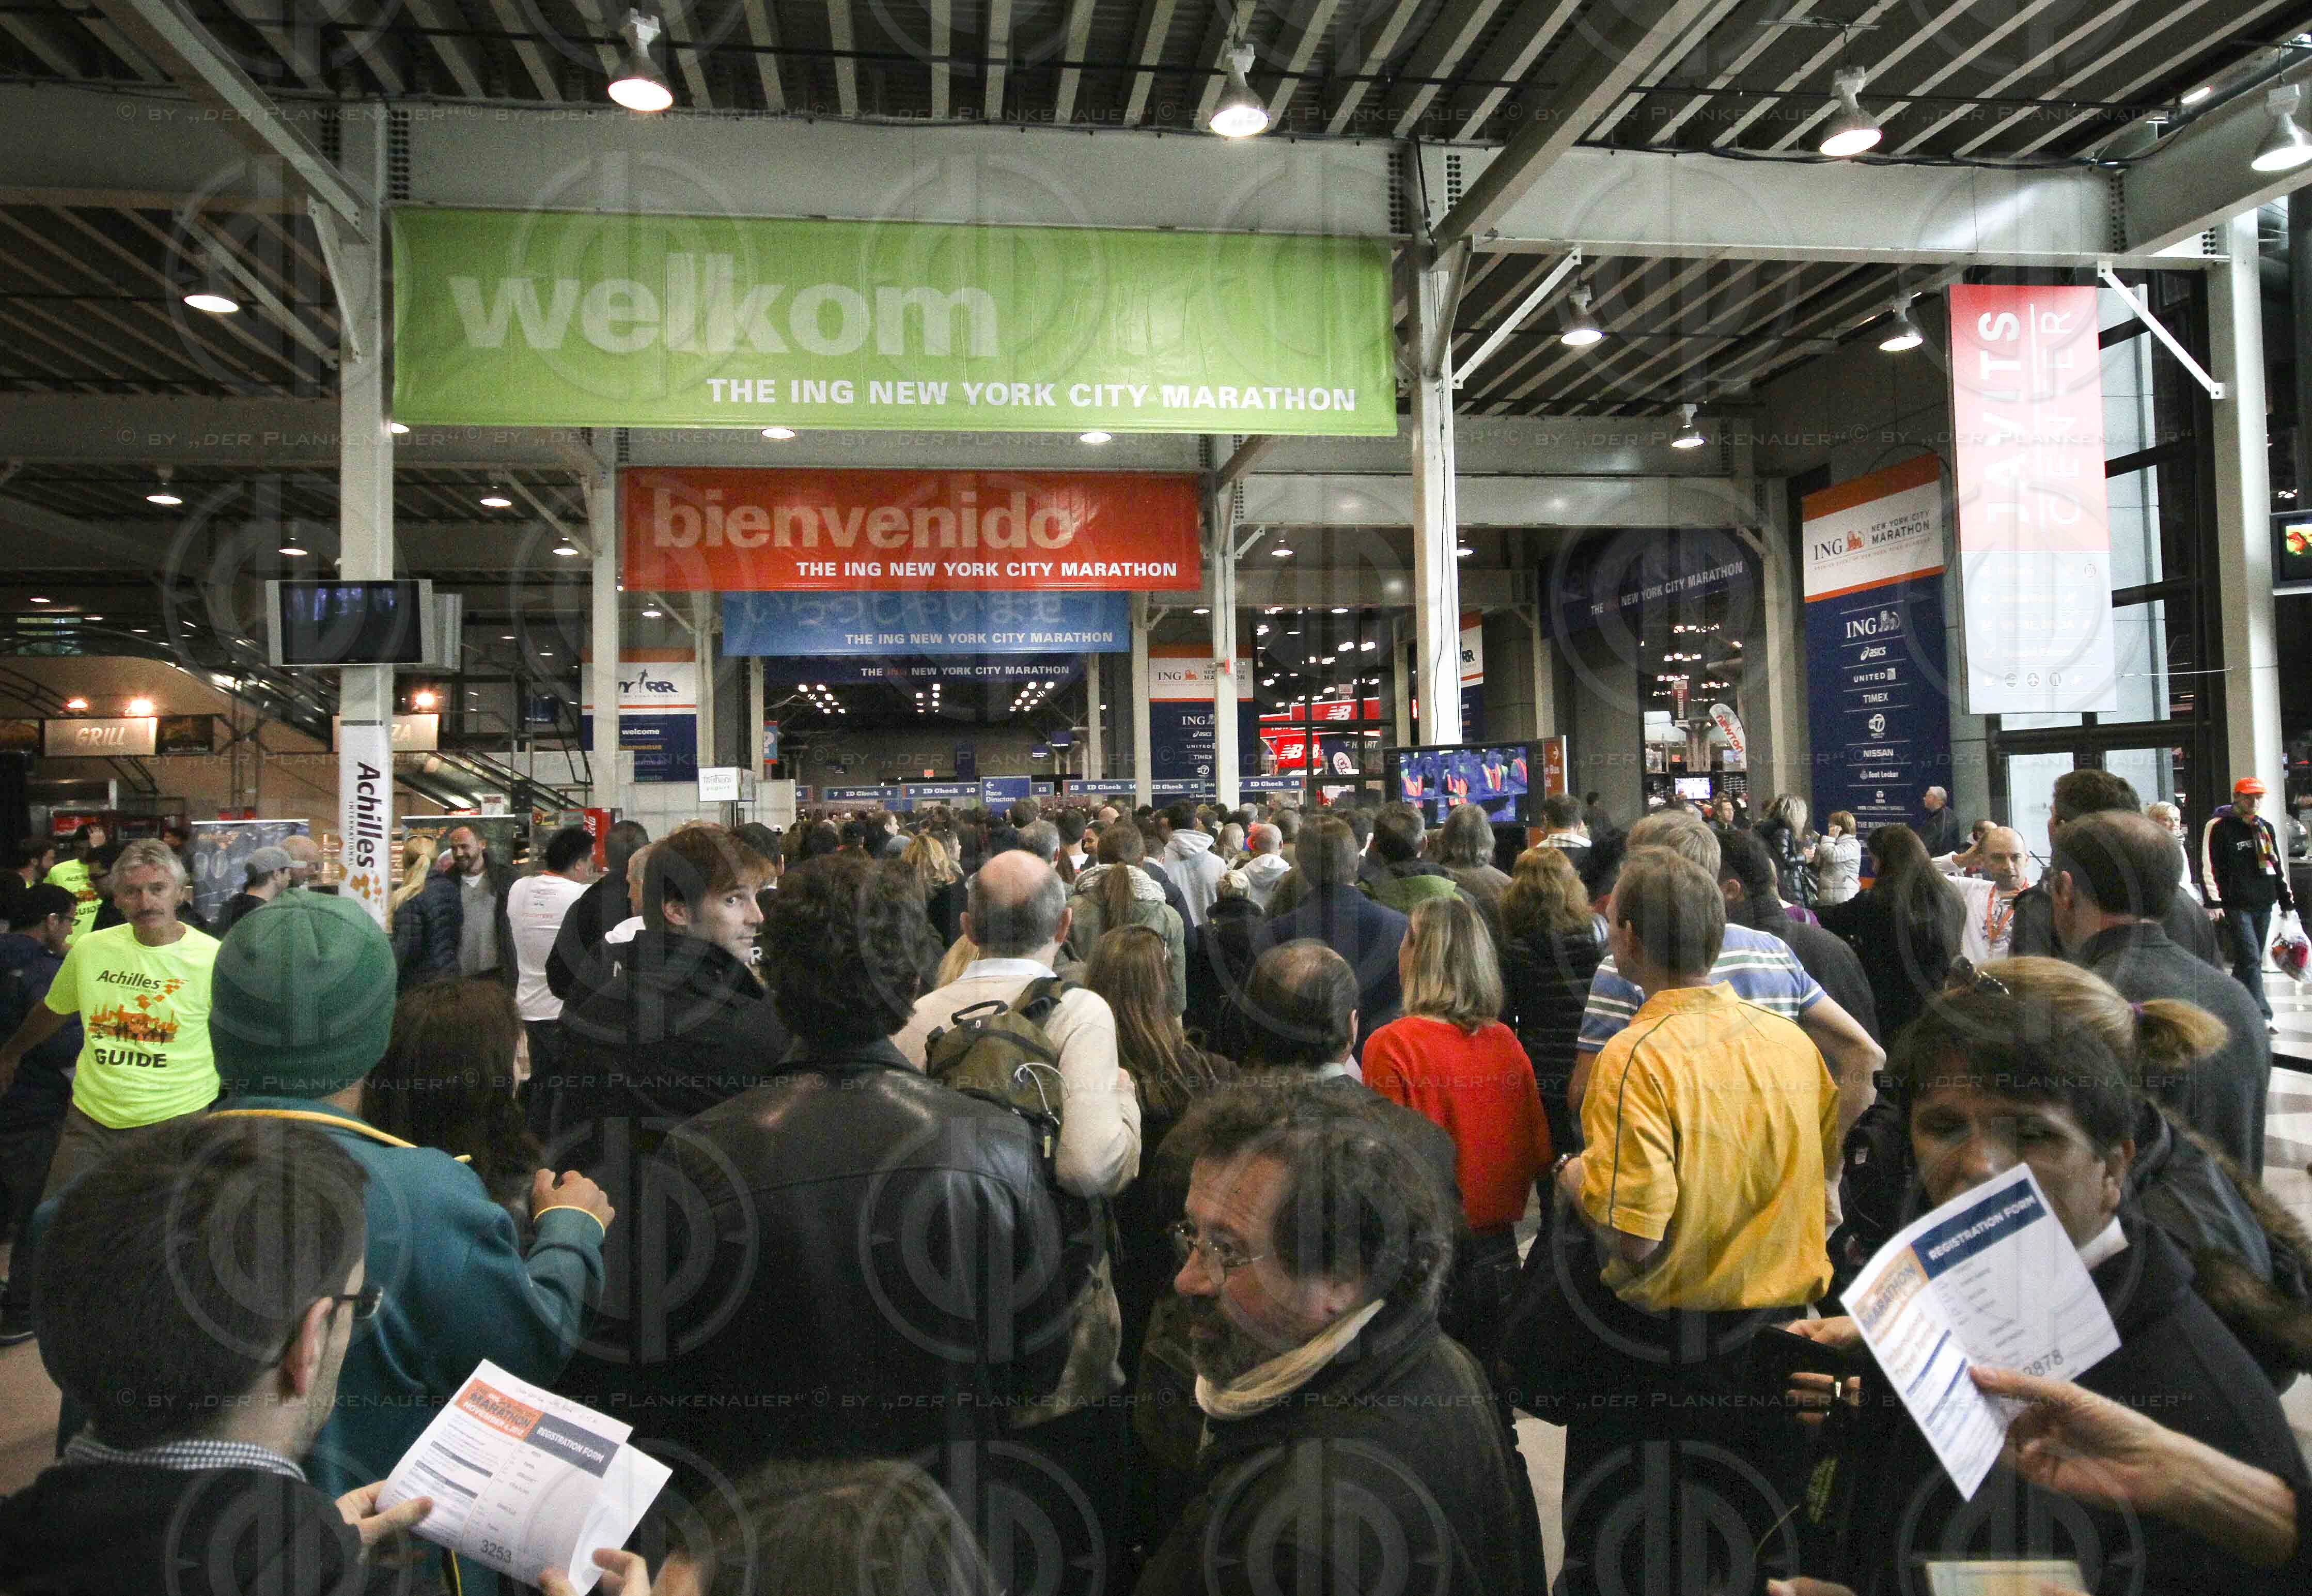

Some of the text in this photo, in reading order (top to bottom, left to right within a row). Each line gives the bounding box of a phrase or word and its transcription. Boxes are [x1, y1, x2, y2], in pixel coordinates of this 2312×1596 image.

[449, 254, 997, 357] welkom
[707, 379, 1355, 411] THE ING NEW YORK CITY MARATHON
[652, 488, 1077, 549] bienvenido
[1871, 510, 1930, 532] NEW YORK CITY
[1871, 521, 1930, 544] MARATHON
[1814, 538, 1842, 560] ING
[796, 562, 1177, 576] THE ING NEW YORK CITY MARATHON
[1590, 561, 1743, 615] THE NEW YORK CITY MARATHON
[1846, 617, 1877, 638] ING
[845, 632, 1112, 645] THE ING NEW YORK CITY MARATHON
[861, 668, 883, 677] THE
[911, 667, 937, 676] NEW
[942, 667, 971, 676] YORK
[975, 666, 1001, 675] CITY
[1005, 665, 1069, 675] MARATHON
[1158, 671, 1181, 681] ING
[1853, 672, 1886, 683] UNITED
[1863, 693, 1888, 703] TIMEX
[1181, 716, 1206, 725] ING
[77, 727, 125, 744] GRILL
[1863, 748, 1894, 757] NISSAN
[357, 761, 383, 869] Achilles
[96, 969, 161, 990] Achilles
[94, 1048, 168, 1069] GUIDE
[1928, 1194, 2037, 1261] REGISTRATION FORM
[537, 1427, 605, 1463] REGISTRATION FORM
[480, 1539, 512, 1563] 3253
